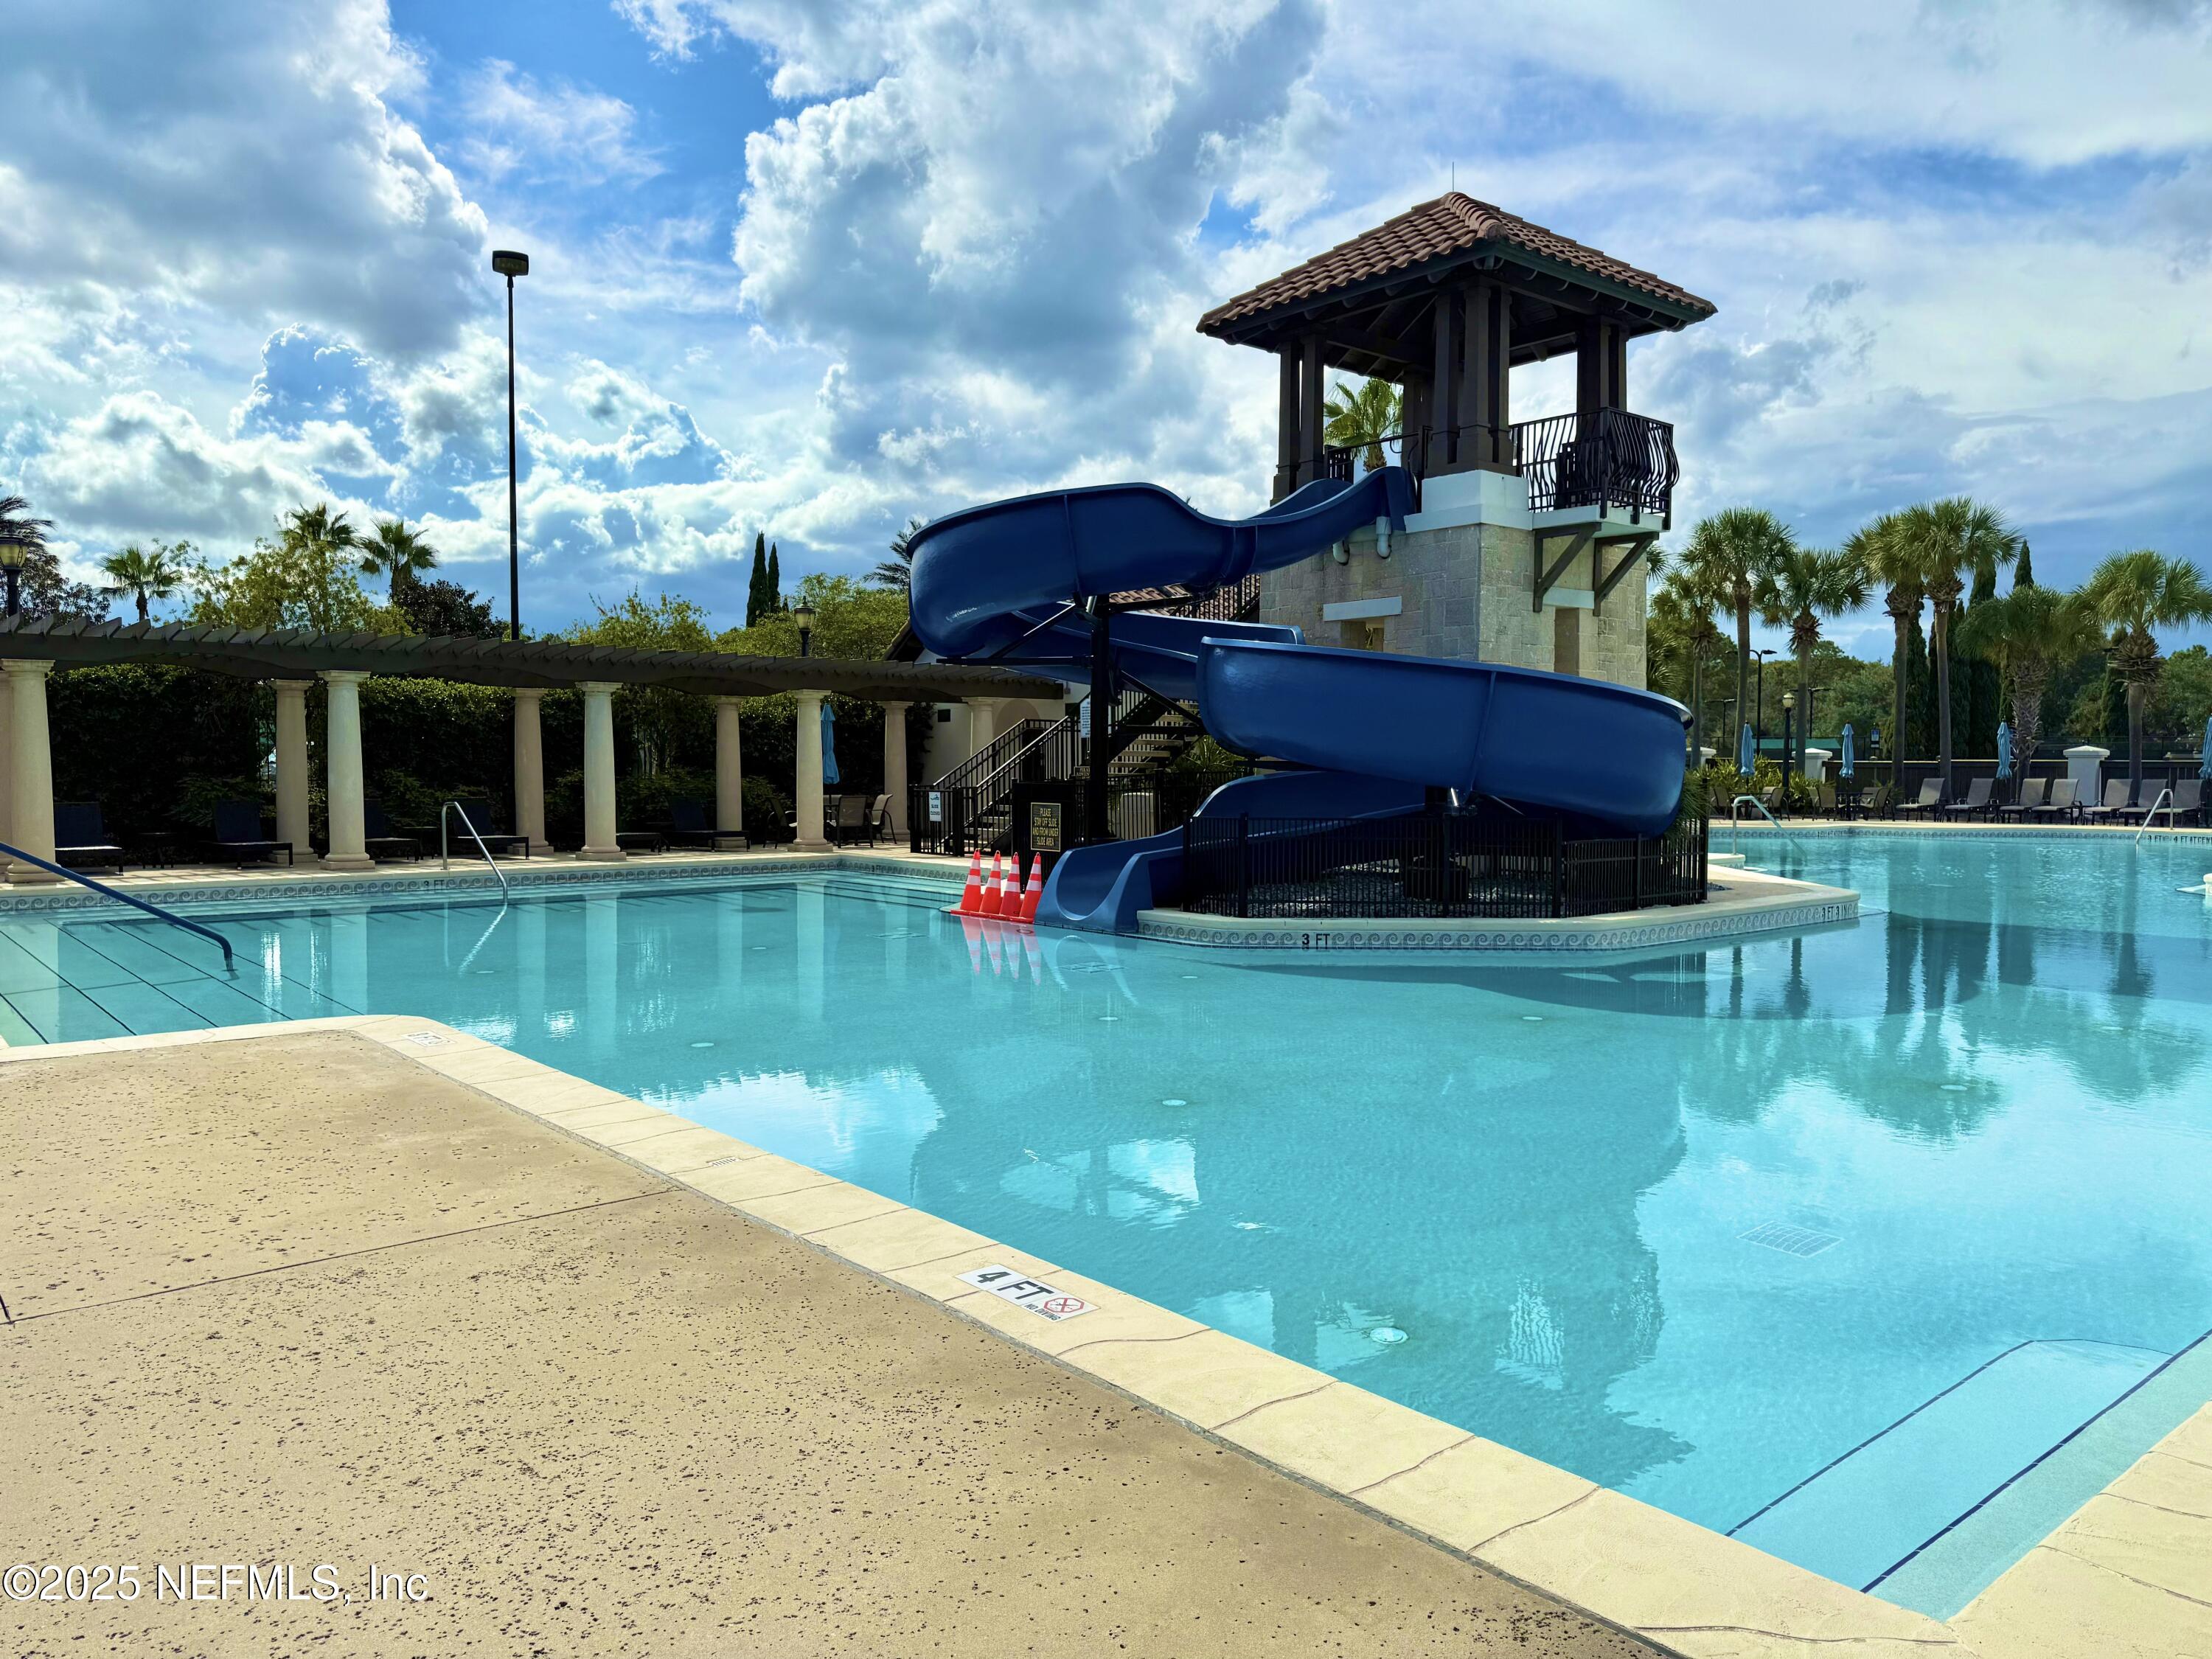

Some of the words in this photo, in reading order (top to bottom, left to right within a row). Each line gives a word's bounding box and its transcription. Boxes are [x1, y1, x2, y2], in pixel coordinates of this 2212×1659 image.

[1040, 808, 1051, 817] PLEASE
[1034, 817, 1042, 826] STAY
[1048, 818, 1057, 827] SLIDE
[1040, 827, 1048, 836] FROM
[1048, 828, 1059, 837] UNDER
[1037, 836, 1046, 846] SLIDE
[1046, 837, 1054, 846] AREA
[2180, 835, 2188, 844] FT
[1828, 906, 1834, 919] FT
[1836, 905, 1840, 919] 3
[1842, 905, 1847, 918] IN
[1301, 933, 1310, 945] 3
[1315, 933, 1330, 946] FT
[977, 1271, 1011, 1284] 4
[997, 1280, 1054, 1300] FT
[1034, 1308, 1061, 1321] DIVING
